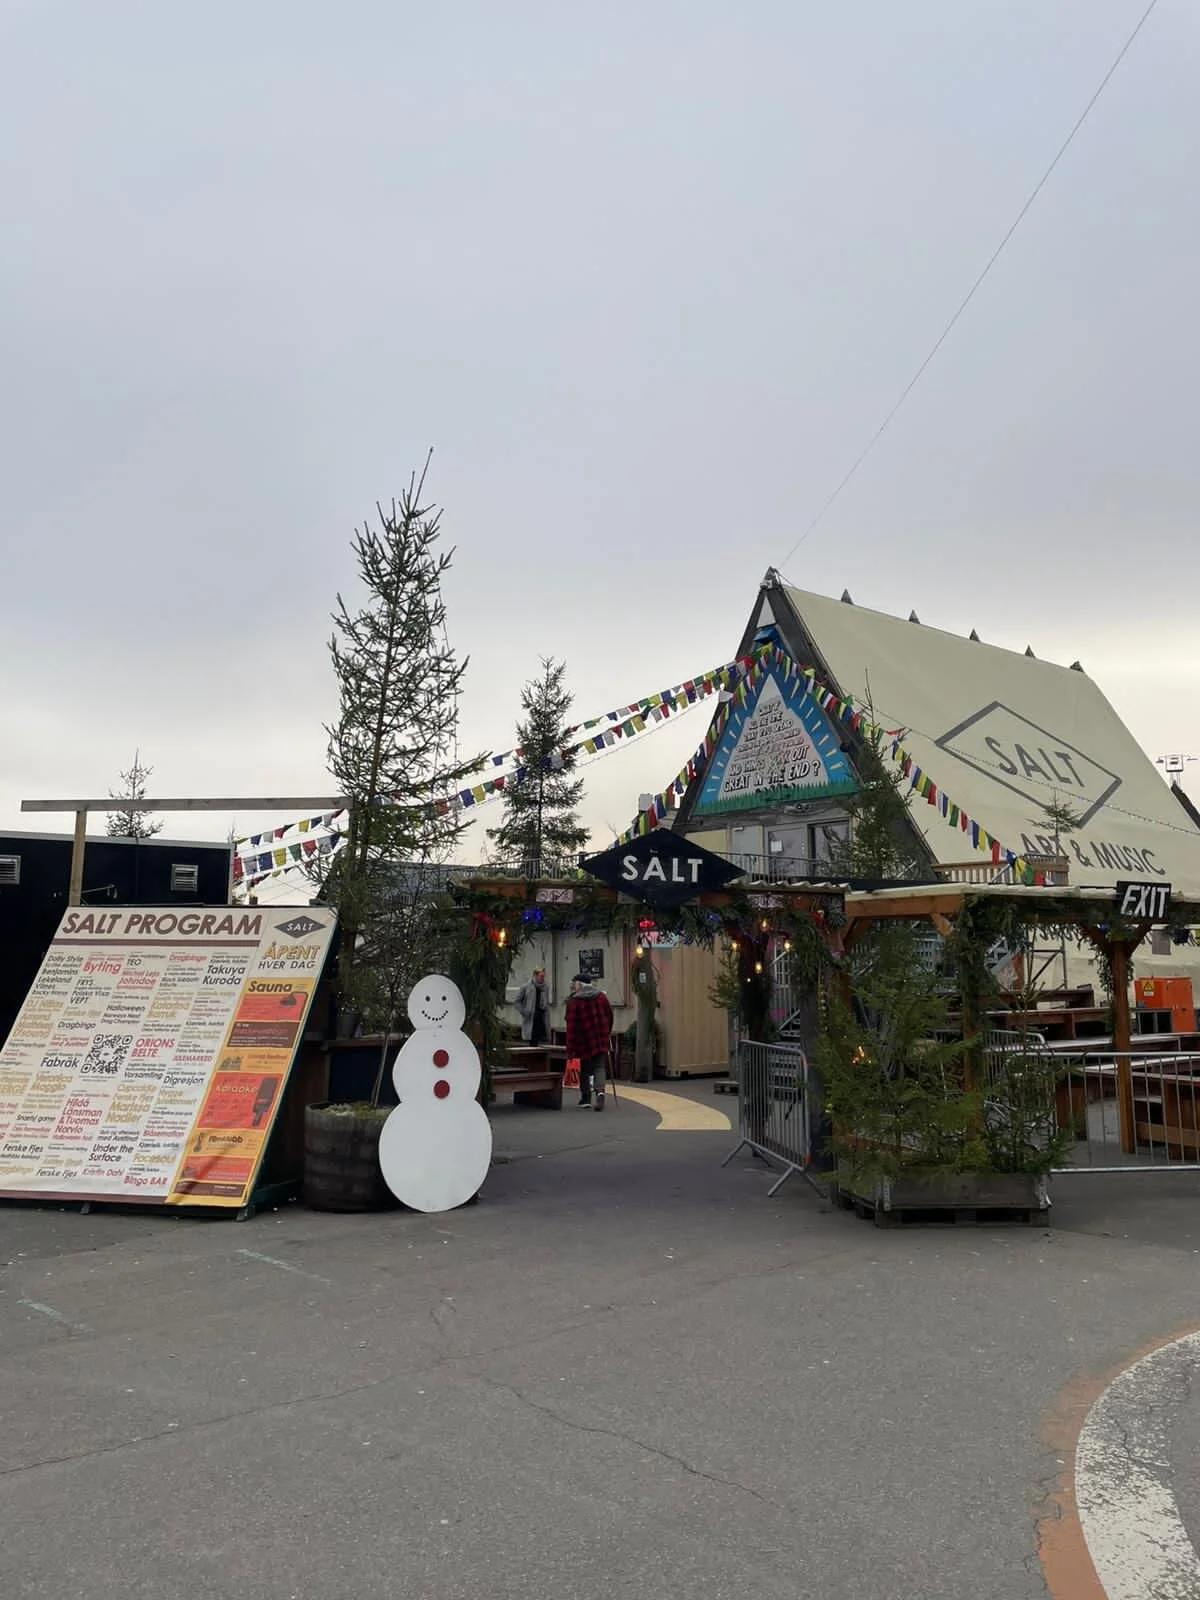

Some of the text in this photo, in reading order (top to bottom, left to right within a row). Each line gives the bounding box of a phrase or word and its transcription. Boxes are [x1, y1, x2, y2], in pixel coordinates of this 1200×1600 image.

[792, 745, 810, 763] OUT
[984, 736, 1085, 788] SALT
[723, 773, 750, 793] GREAT
[788, 760, 811, 782] END
[1020, 833, 1166, 876] ART & MUSIC
[622, 855, 704, 883] SALT
[1120, 885, 1170, 918] EXIT
[62, 912, 262, 937] SALT PROGRAM
[287, 922, 315, 932] SALT
[262, 942, 321, 960] ÅPENT
[207, 964, 245, 976] Takuya
[257, 960, 316, 969] HVER DAG
[203, 975, 241, 986] Kuroda
[247, 979, 293, 993] Sauna
[106, 1004, 146, 1012] Halloween
[57, 1021, 96, 1030] Dragbingo
[135, 1038, 176, 1048] ORIONS
[131, 1048, 158, 1057] BELTE
[163, 1075, 204, 1086] Digresjon
[3, 1143, 28, 1152] Ferske
[92, 1143, 118, 1153] Under
[118, 1144, 134, 1153] the
[89, 1152, 122, 1162] Surface
[123, 1175, 149, 1186] Bingo
